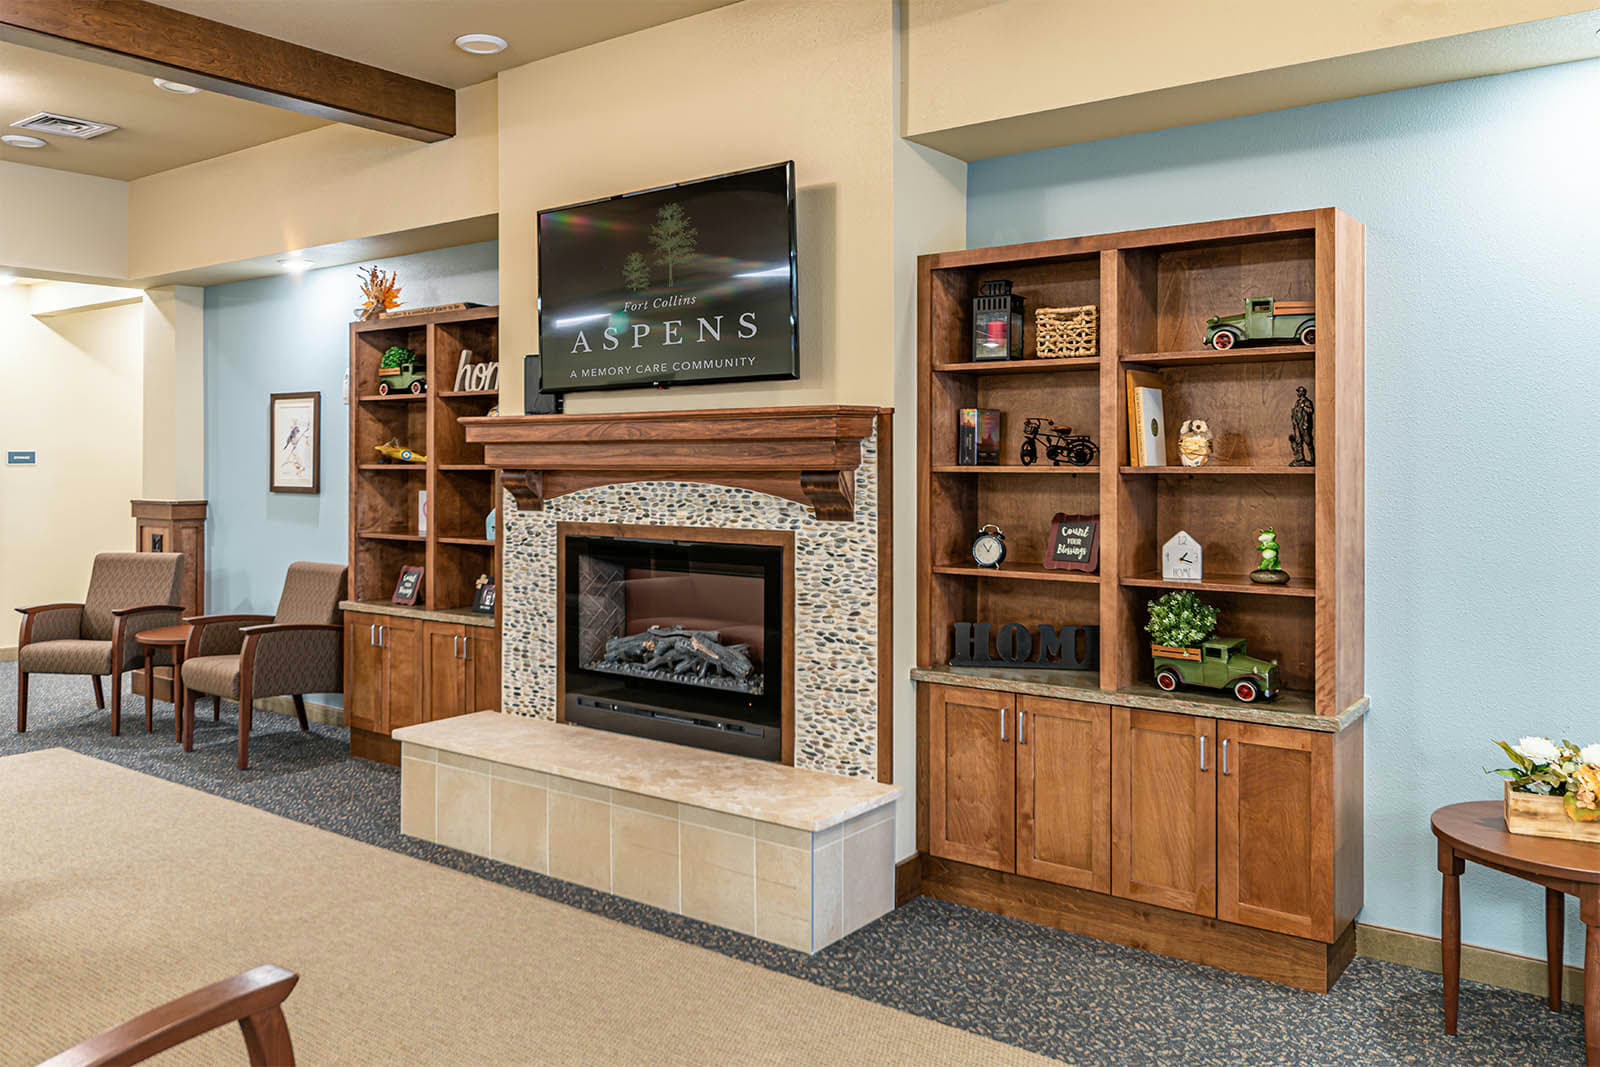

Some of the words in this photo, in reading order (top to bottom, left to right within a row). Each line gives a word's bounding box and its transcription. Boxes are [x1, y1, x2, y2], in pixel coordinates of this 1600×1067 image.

[623, 301, 648, 313] Fort
[653, 294, 697, 309] Collins
[571, 311, 758, 354] ASPENS
[569, 370, 578, 379] A
[581, 366, 632, 378] MEMORY
[635, 363, 668, 375] CARE
[672, 356, 756, 372] COMMUNITY
[1061, 525, 1090, 538] Count
